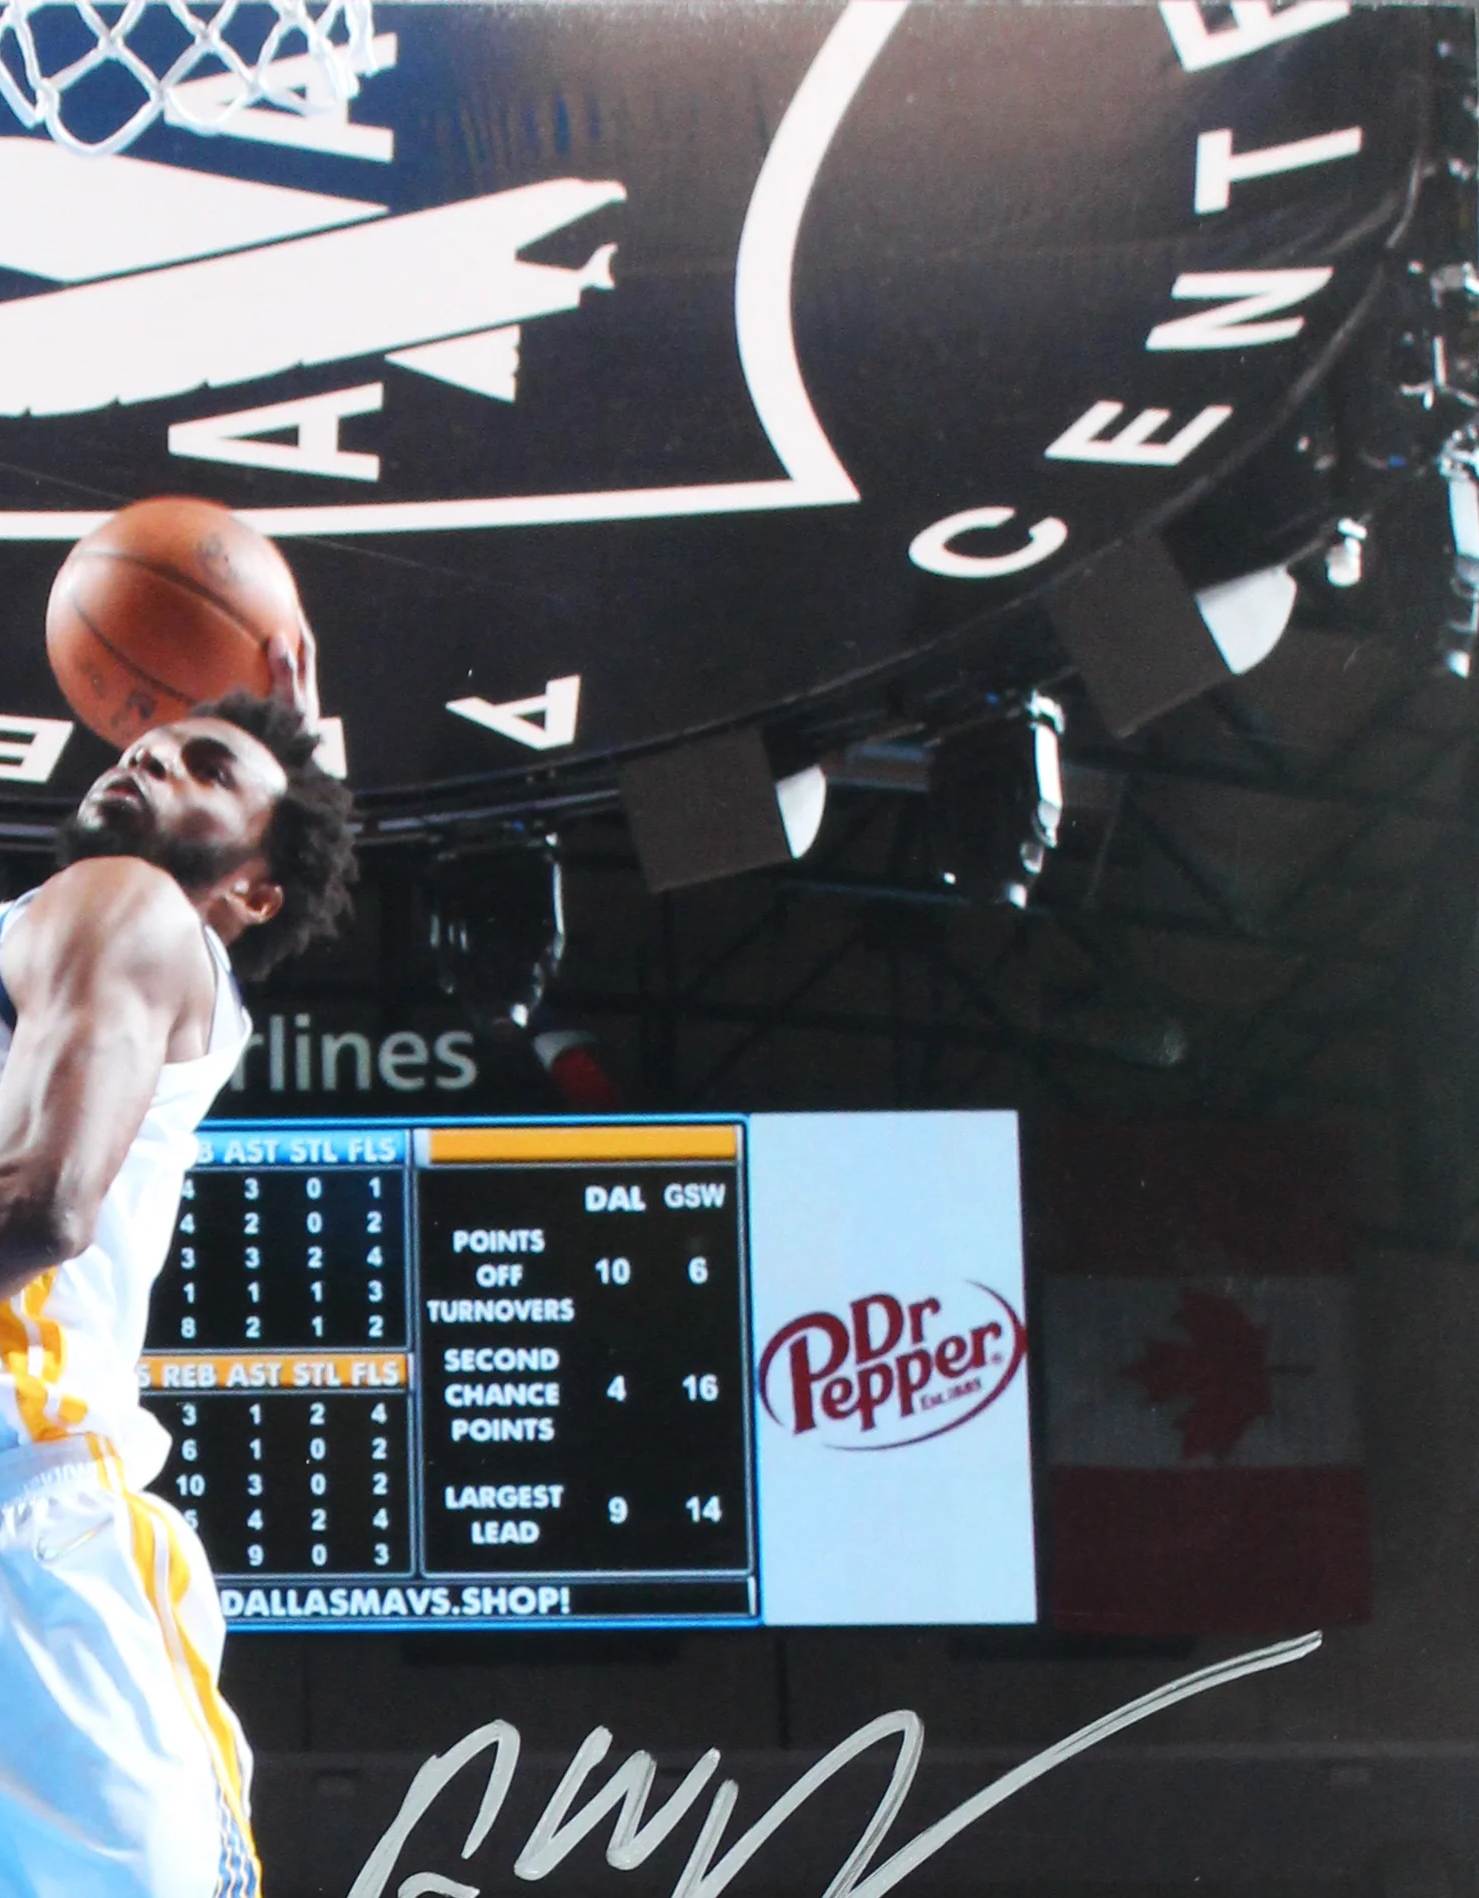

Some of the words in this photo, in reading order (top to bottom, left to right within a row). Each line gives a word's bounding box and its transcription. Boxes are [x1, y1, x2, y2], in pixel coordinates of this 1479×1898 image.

[224, 1137, 278, 1163] AST
[289, 1136, 338, 1163] STL
[348, 1135, 397, 1162] FLS
[180, 1177, 196, 1199] 4
[244, 1177, 260, 1199] 3
[306, 1177, 322, 1199] 0
[369, 1177, 381, 1199] 1
[584, 1185, 646, 1212] DAL
[663, 1183, 725, 1210] GSW
[180, 1213, 196, 1234] 4
[244, 1213, 260, 1234] 2
[306, 1213, 322, 1234] 0
[366, 1213, 382, 1234] 2
[452, 1228, 545, 1254] POINTS
[180, 1247, 196, 1269] 3
[245, 1247, 261, 1269] 3
[307, 1247, 323, 1269] 2
[366, 1247, 383, 1269] 4
[475, 1263, 523, 1288] OFF
[594, 1258, 631, 1284] 10
[688, 1257, 709, 1284] 6
[183, 1281, 196, 1304] 1
[248, 1281, 260, 1304] 1
[310, 1281, 323, 1304] 1
[368, 1281, 383, 1304] 3
[426, 1297, 575, 1324] TURNOVERS
[180, 1315, 197, 1339] 8
[245, 1315, 262, 1339] 2
[311, 1315, 324, 1339] 1
[368, 1315, 385, 1339] 2
[850, 1293, 942, 1365] Dr
[443, 1347, 560, 1372] SECOND
[161, 1362, 217, 1388] REB
[226, 1361, 283, 1388] AST
[292, 1361, 342, 1388] STL
[350, 1359, 400, 1387] FLS
[759, 1311, 1002, 1435] Pepper
[444, 1381, 560, 1408] CHANCE
[606, 1375, 626, 1401] 4
[682, 1374, 718, 1401] 16
[181, 1403, 198, 1426] 3
[249, 1403, 262, 1426] 1
[309, 1403, 326, 1426] 2
[371, 1403, 388, 1426] 4
[451, 1417, 555, 1443] POINTS
[181, 1438, 198, 1461] 6
[249, 1438, 262, 1461] 1
[310, 1438, 326, 1461] 0
[371, 1438, 388, 1461] 2
[175, 1474, 206, 1496] 10
[247, 1474, 264, 1496] 3
[310, 1474, 327, 1496] 0
[372, 1474, 389, 1496] 2
[444, 1484, 564, 1510] LARGEST
[607, 1497, 628, 1524] 9
[685, 1496, 722, 1523] 14
[246, 1509, 264, 1531] 4
[311, 1509, 327, 1531] 2
[372, 1509, 390, 1531] 4
[470, 1519, 539, 1545] LEAD
[247, 1544, 264, 1566] 9
[311, 1544, 328, 1566] 0
[374, 1544, 391, 1566] 3
